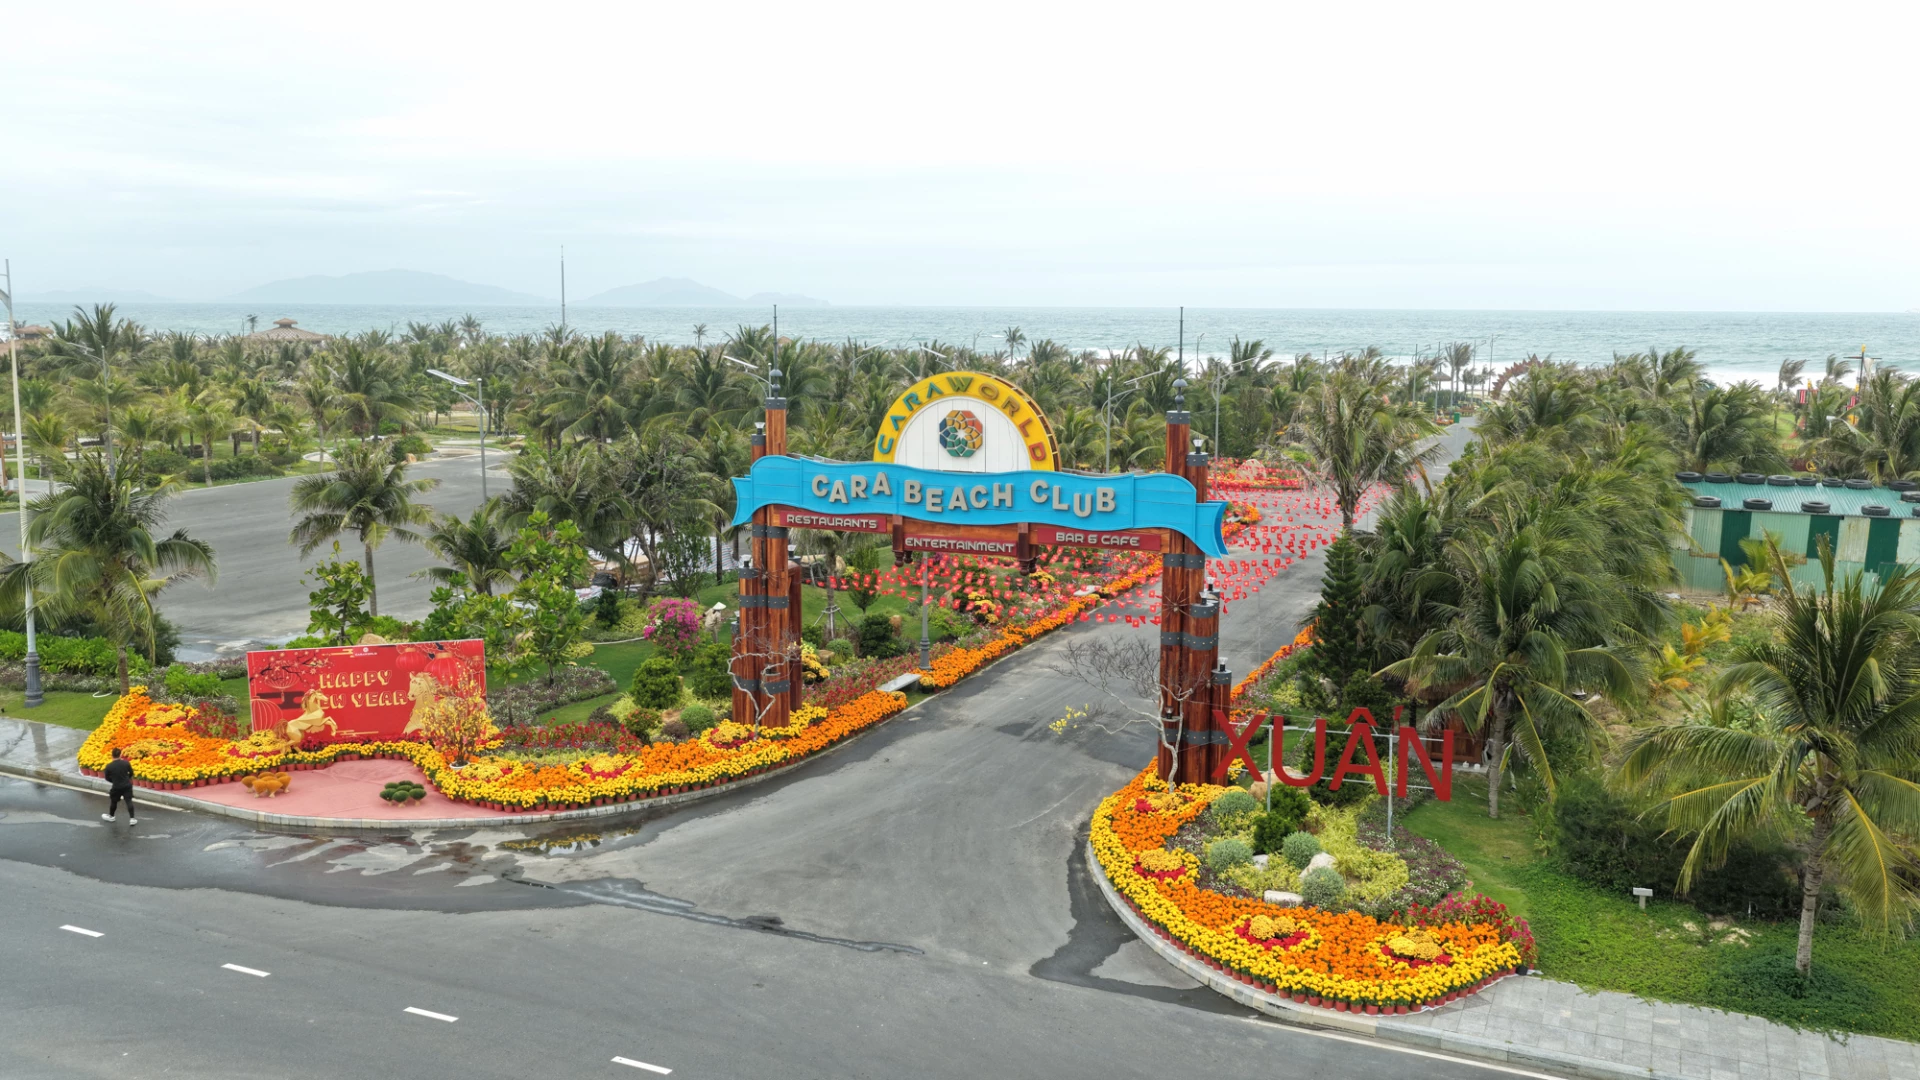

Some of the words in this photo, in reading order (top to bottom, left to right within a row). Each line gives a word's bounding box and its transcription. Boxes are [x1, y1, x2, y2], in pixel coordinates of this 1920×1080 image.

[877, 376, 1048, 462] CARAWORLD
[811, 471, 893, 504] CARA
[904, 479, 1014, 513] BEACH
[1030, 479, 1117, 518] CLUB
[786, 513, 878, 529] RESTAURANTS
[904, 537, 1015, 553] ENTERTAINMENT
[1055, 530, 1084, 544] BAR
[1101, 534, 1140, 547] CAFE
[319, 669, 393, 689] HAPPY
[319, 693, 347, 710] EW
[351, 689, 408, 708] YEAR
[523, 730, 583, 748] 2026
